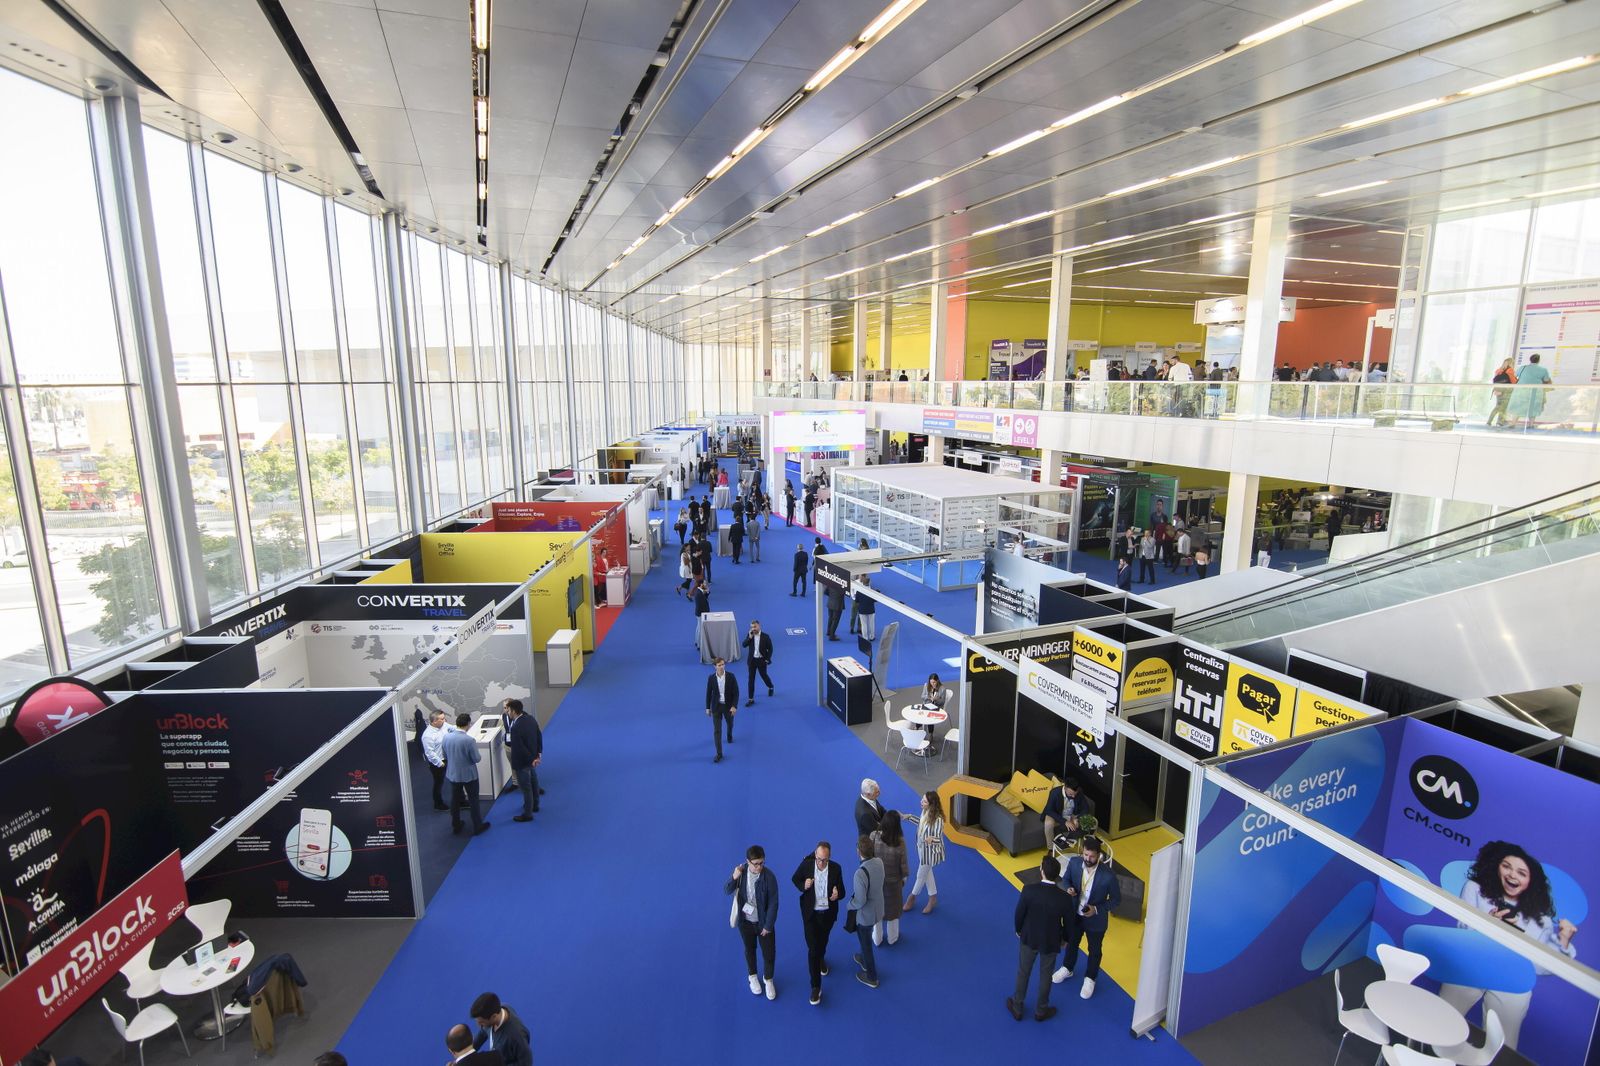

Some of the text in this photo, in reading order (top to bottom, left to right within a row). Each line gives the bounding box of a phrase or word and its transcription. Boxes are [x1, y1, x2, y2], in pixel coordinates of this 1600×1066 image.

[357, 594, 467, 607] CONVERTIX
[422, 609, 467, 617] TRAVEL
[460, 609, 495, 644] CONVERTIX
[1075, 639, 1103, 657] +6000
[1051, 653, 1071, 661] Partner
[1183, 648, 1224, 671] Centraliza
[1133, 667, 1168, 679] Automatiza
[1185, 661, 1220, 681] reservas
[1132, 676, 1167, 688] reservas por
[1037, 676, 1094, 715] COVERMANAGER
[1136, 686, 1162, 696] teléfono
[1242, 683, 1276, 706] Pagar
[169, 733, 203, 741] superapp
[1190, 728, 1212, 744] COVER
[1190, 736, 1211, 750] Bookings
[1250, 728, 1274, 744] COVER
[163, 748, 194, 756] negocios
[1298, 767, 1346, 794] every
[2, 812, 41, 839] ATERRIZADO
[10, 810, 33, 826] HEMOS
[1403, 807, 1472, 847] CM.com
[167, 900, 185, 921] 2C52
[37, 894, 156, 1007] unBlock
[43, 917, 157, 1018] LA CARA SMART DE LA CIUDAD
